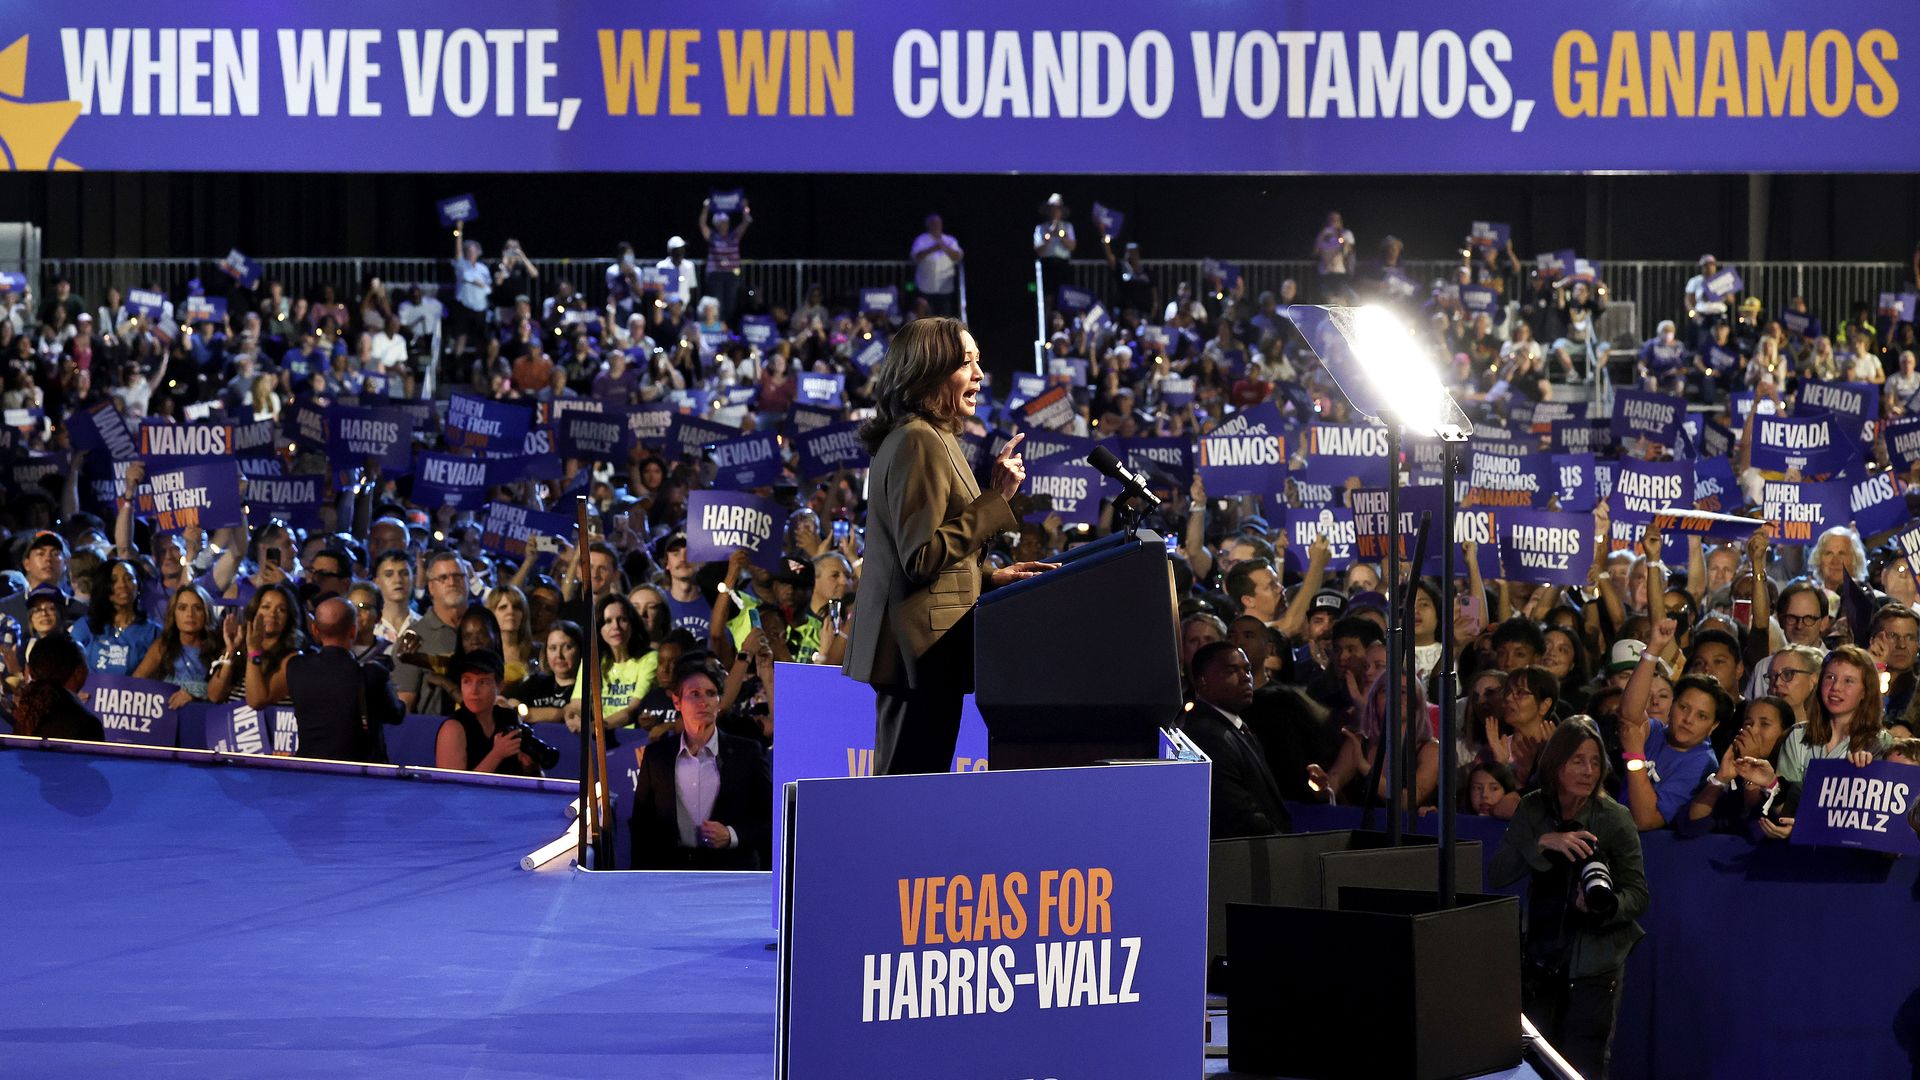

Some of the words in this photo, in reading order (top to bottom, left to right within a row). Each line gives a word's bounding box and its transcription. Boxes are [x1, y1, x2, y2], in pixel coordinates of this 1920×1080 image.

[60, 28, 260, 116] WHEN
[277, 28, 382, 117] WE
[397, 29, 582, 131] VOTE,
[597, 29, 702, 116] WE
[717, 29, 856, 116] WIN
[892, 29, 1175, 119] CUANDO
[1190, 29, 1536, 132] VOTAMOS,
[1552, 28, 1900, 118] GANAMOS
[451, 394, 485, 418] WHEN
[1803, 383, 1862, 415] NEVADA
[1623, 399, 1676, 424] HARRIS
[341, 419, 399, 443] HARRIS
[450, 412, 464, 430] WE
[467, 416, 502, 438] FIGHT,
[569, 420, 620, 443] HARRIS
[1629, 417, 1665, 434] WALZ
[1761, 420, 1831, 449] NEVADA
[141, 425, 234, 455] ¡VAMOS!
[348, 440, 388, 455] WALZ
[576, 438, 612, 454] WALZ
[1200, 436, 1286, 466] ¡VAMOS!
[821, 449, 859, 465] WALZ
[1473, 452, 1520, 475] CUANDO
[151, 471, 185, 494] WHEN
[423, 458, 486, 486] NEVADA
[1471, 469, 1540, 493] LUCHAMOS,
[1617, 469, 1682, 499] HARRIS
[153, 491, 172, 513] WE
[172, 487, 212, 510] FIGHT,
[248, 479, 315, 503] NEVADA
[1031, 476, 1088, 500] HARRIS
[1470, 487, 1532, 507] GANAMOS
[1765, 483, 1799, 503] WHEN
[490, 501, 528, 525] WHEN
[1353, 491, 1389, 514] WHEN
[1624, 496, 1672, 513] WALZ
[1764, 501, 1782, 520] WE
[1785, 503, 1825, 525] FIGHT,
[157, 511, 176, 531] WE
[174, 507, 199, 528] WIN
[486, 517, 505, 536] WE
[703, 504, 772, 540] HARRIS
[1355, 514, 1375, 535] WE
[1377, 512, 1418, 536] FIHT,
[1653, 513, 1676, 529] WE
[1679, 516, 1714, 531] WIN
[1784, 522, 1812, 539] WIN
[712, 530, 760, 552] WALZ
[1512, 524, 1580, 554] HARRIS
[1611, 523, 1632, 541] WE
[1357, 535, 1377, 557] WE
[1520, 552, 1570, 570] WALZ
[94, 687, 165, 719] HARRIS
[102, 713, 152, 733] WALZ
[274, 731, 293, 752] WE
[1818, 776, 1909, 815] HARRIS
[1827, 809, 1890, 832] WALZ
[898, 871, 1028, 946] VEGAS
[1038, 867, 1114, 938] FOR
[861, 937, 1142, 1023] HARRIS-WALZ
